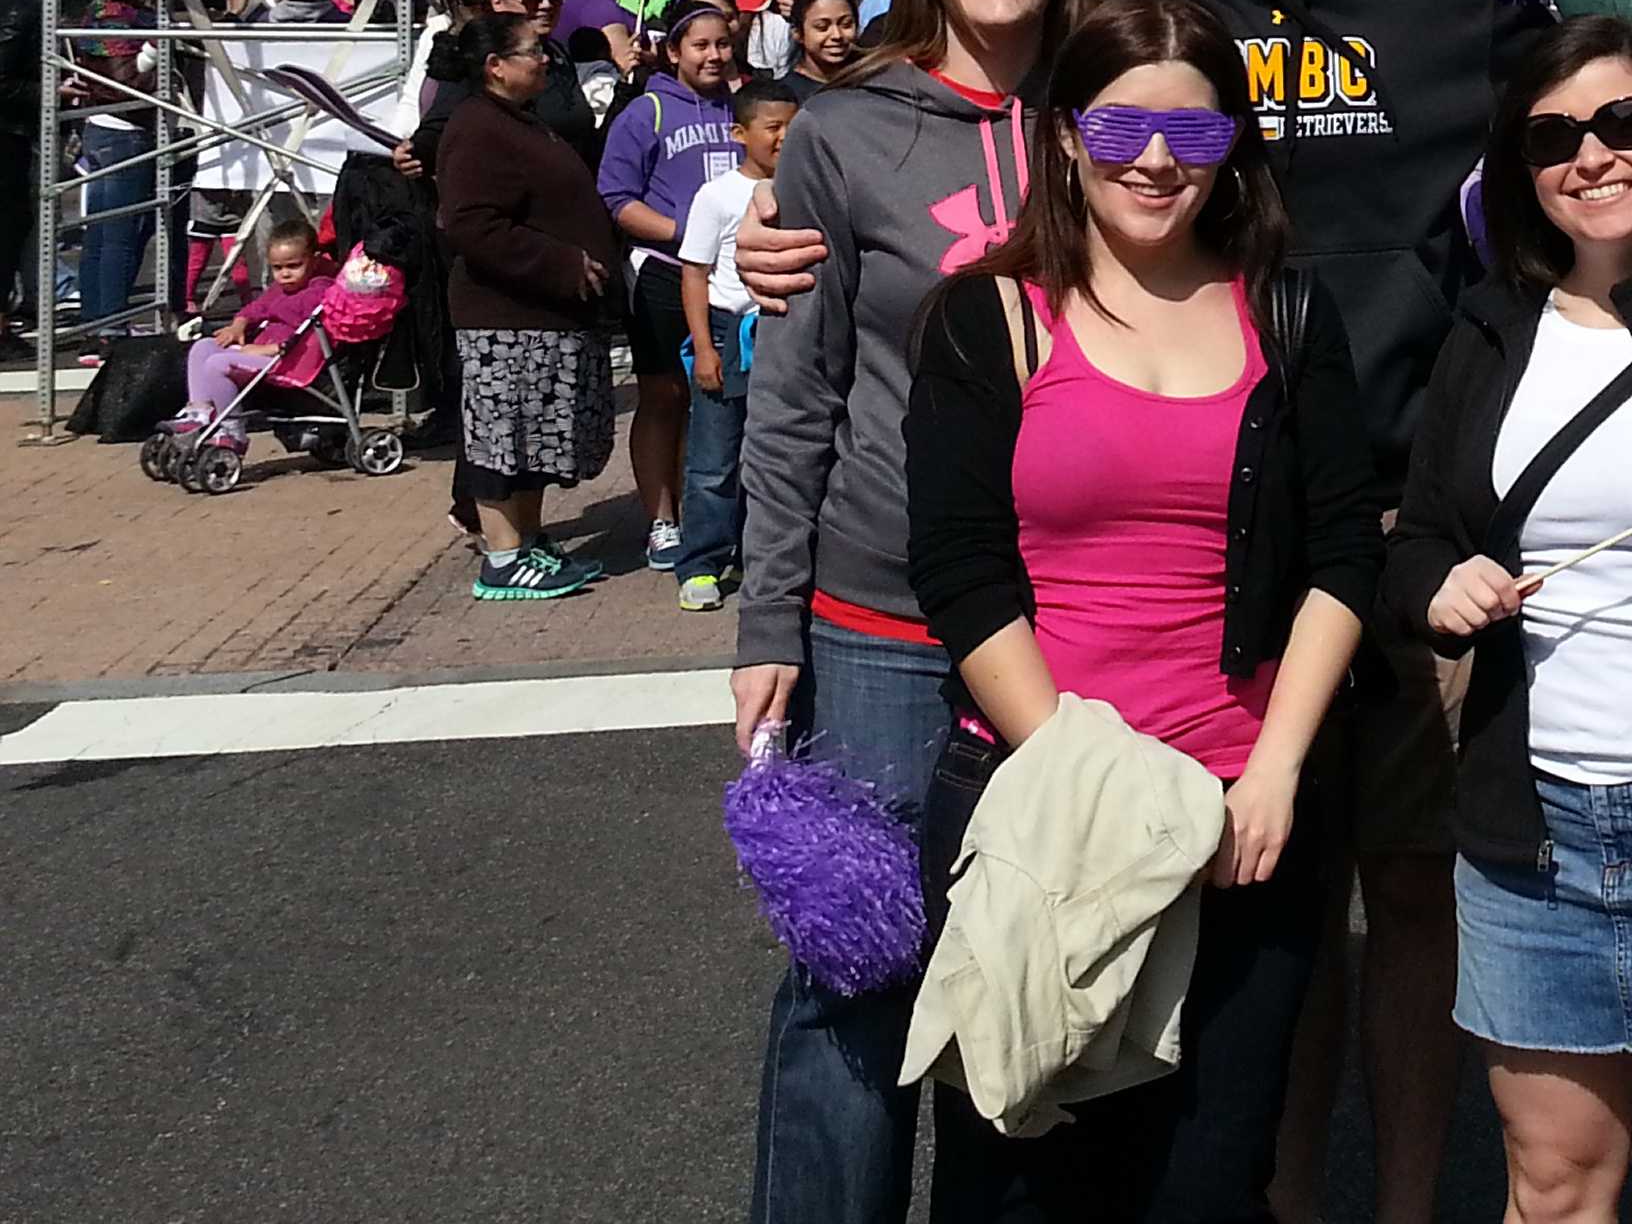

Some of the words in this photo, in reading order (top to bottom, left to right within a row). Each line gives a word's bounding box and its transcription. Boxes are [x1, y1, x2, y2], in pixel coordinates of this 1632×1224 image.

[1234, 37, 1376, 110] MBC
[665, 122, 720, 160] MIAMI
[1280, 112, 1392, 138] TRIEVERS
